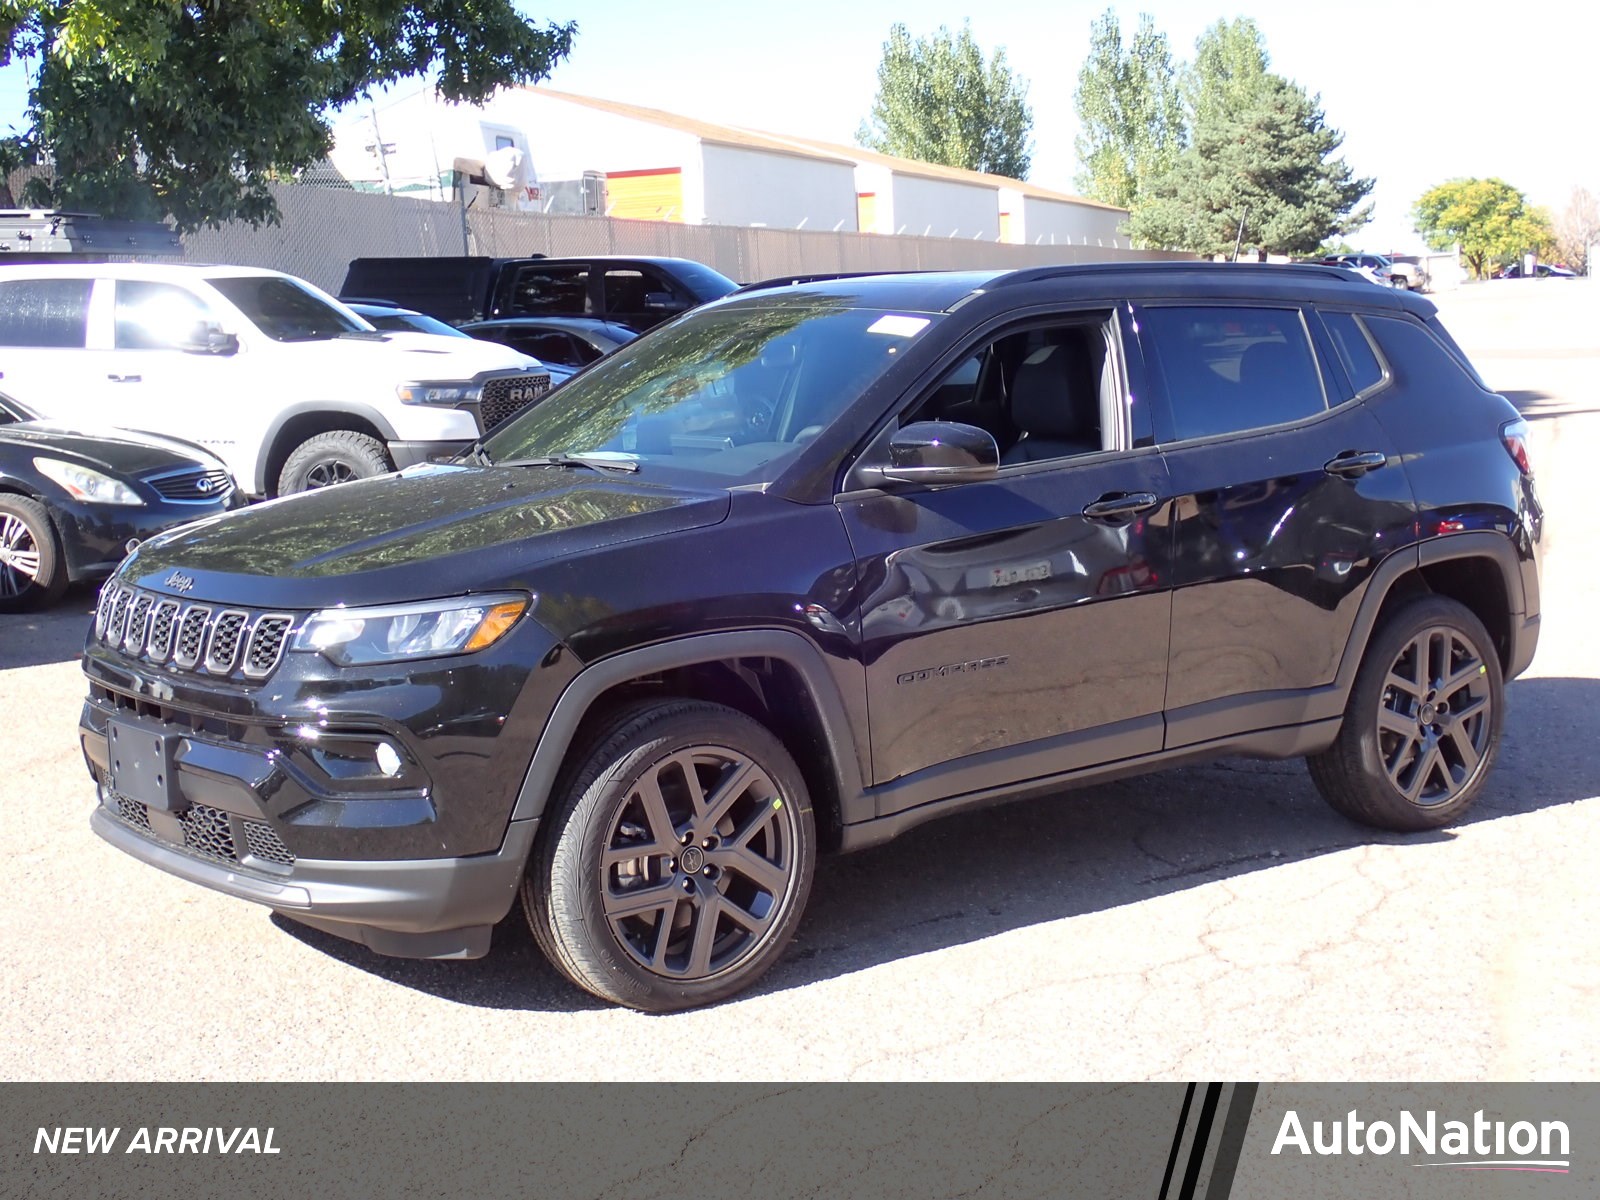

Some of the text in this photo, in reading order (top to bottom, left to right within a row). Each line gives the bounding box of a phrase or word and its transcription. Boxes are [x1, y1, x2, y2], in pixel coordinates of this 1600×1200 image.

[510, 385, 543, 400] RAM
[164, 570, 193, 594] Jeep
[897, 655, 1010, 685] COMPASS
